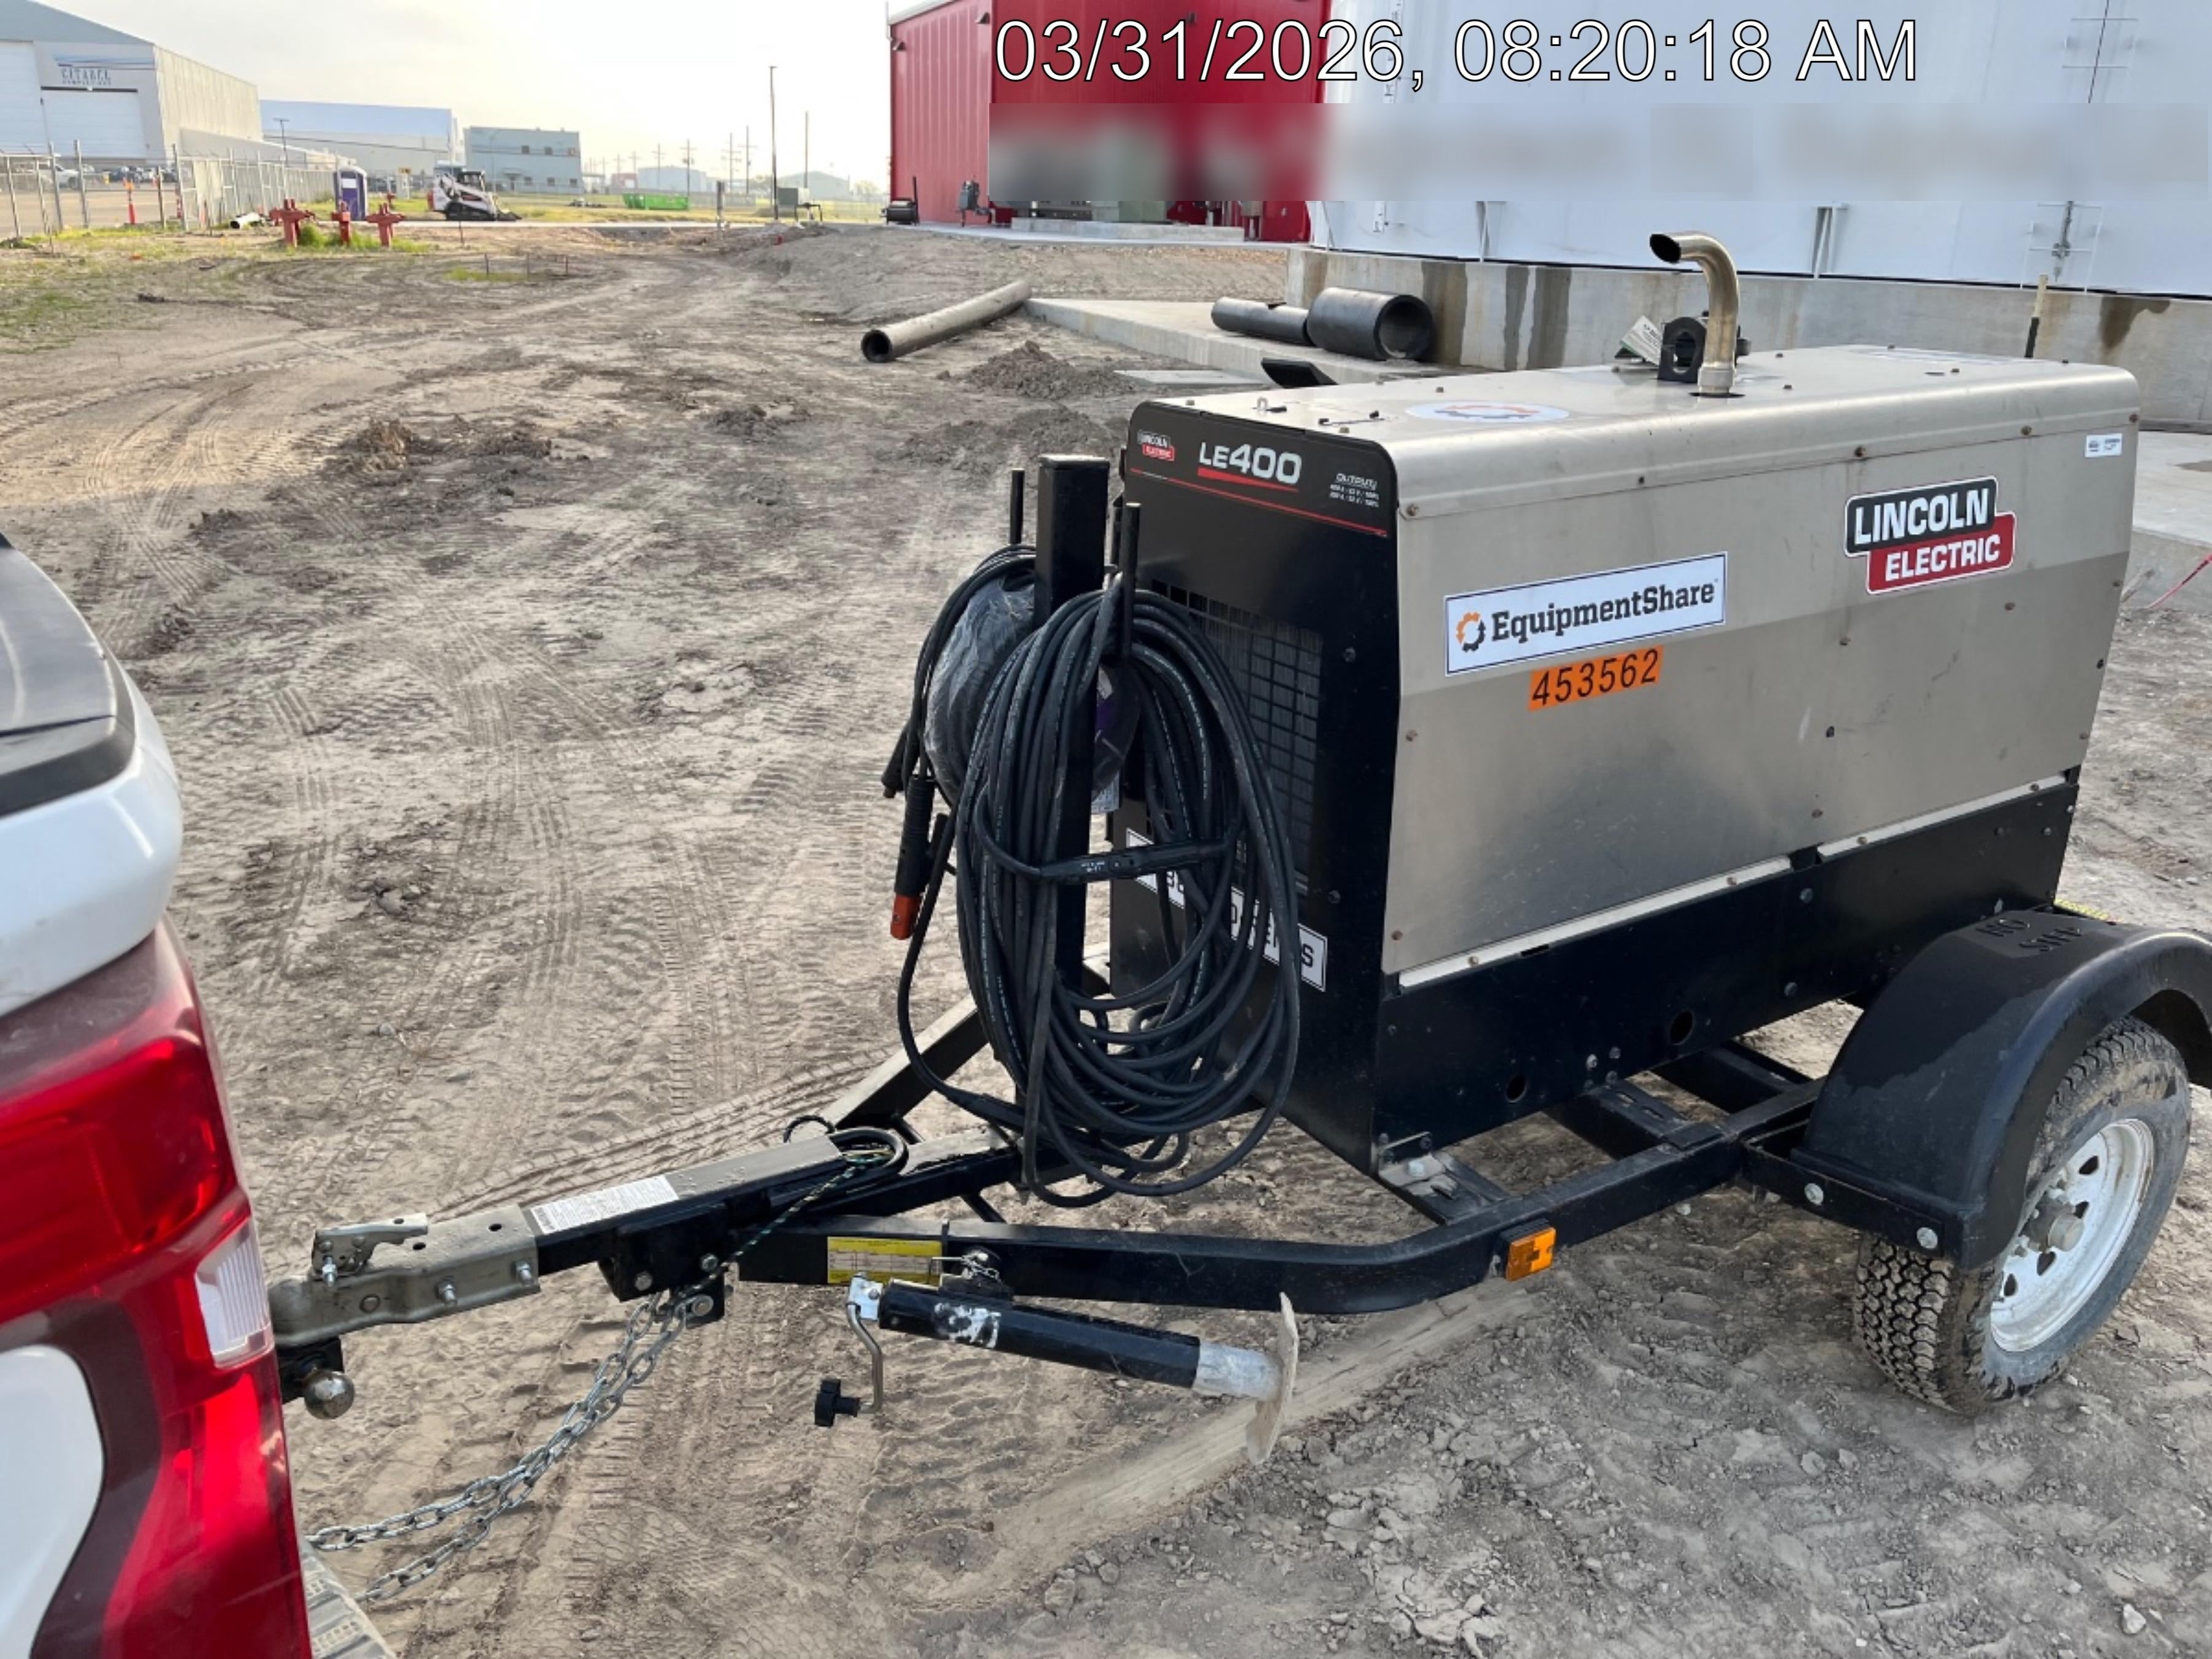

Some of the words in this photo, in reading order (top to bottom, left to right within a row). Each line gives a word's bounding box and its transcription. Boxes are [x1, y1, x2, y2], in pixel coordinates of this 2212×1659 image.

[1199, 442, 1302, 484] LE400
[1854, 488, 1989, 545] LINCOLN
[1885, 534, 2001, 581] ELECTRIC
[1491, 583, 1714, 643] EquipmentShare
[1532, 648, 1658, 706] 453562
